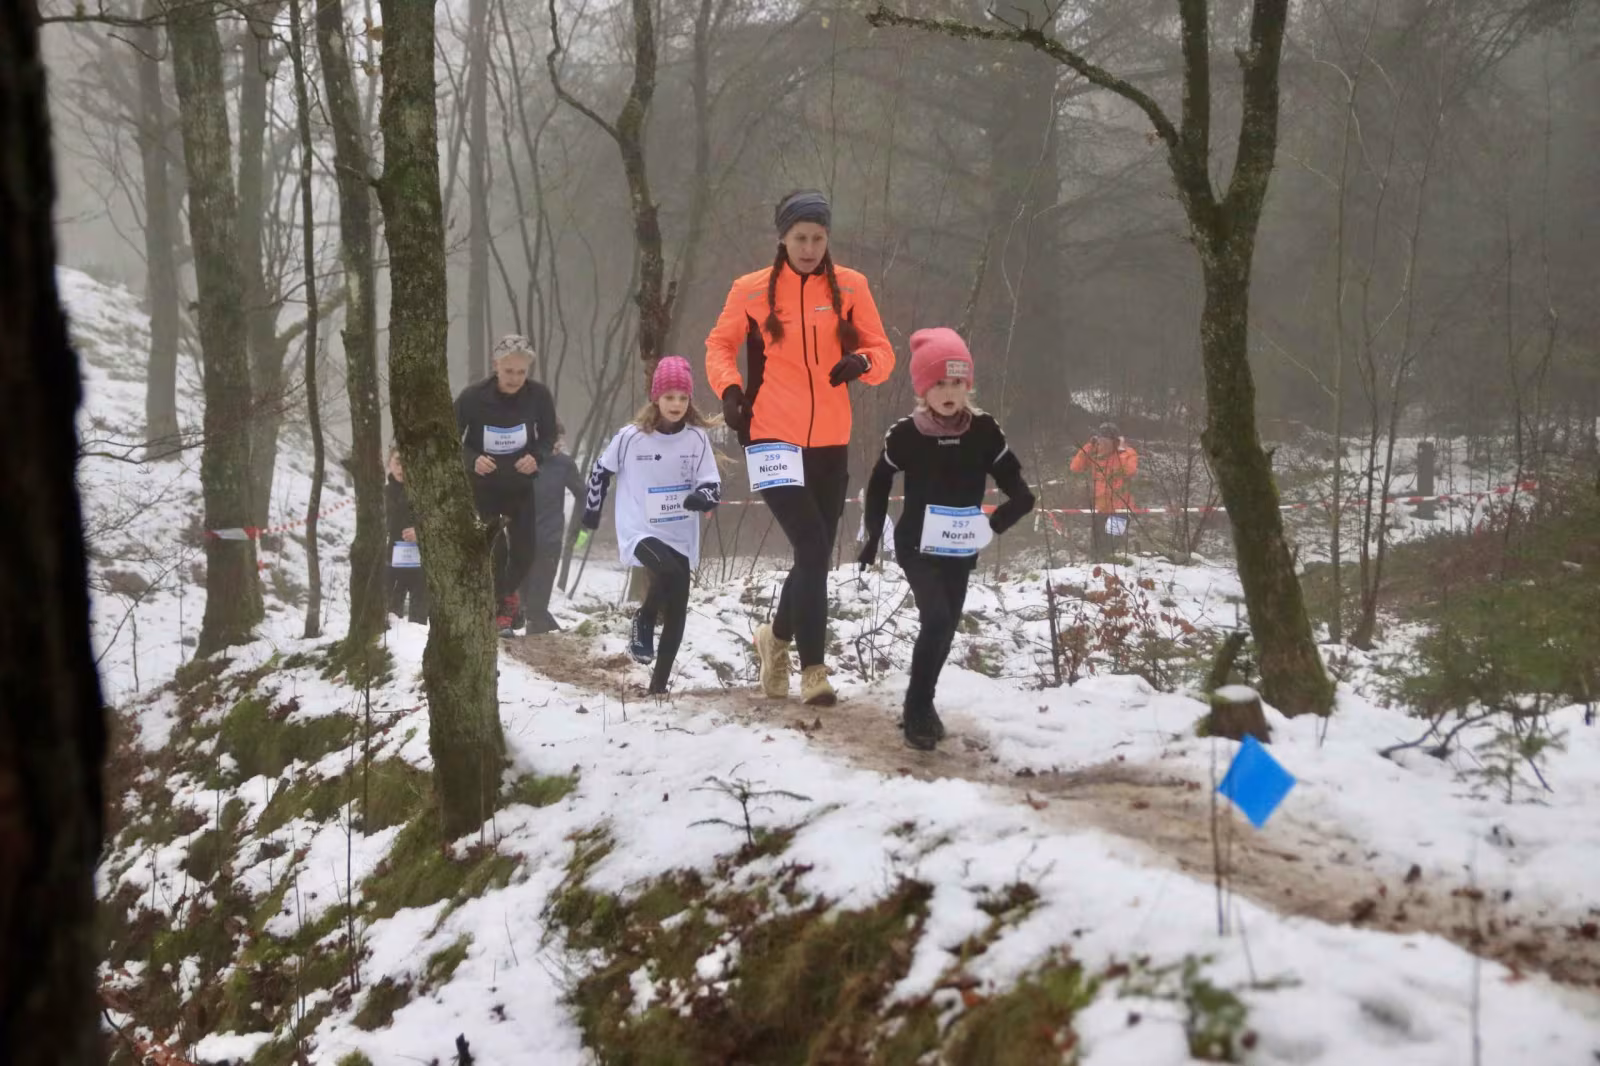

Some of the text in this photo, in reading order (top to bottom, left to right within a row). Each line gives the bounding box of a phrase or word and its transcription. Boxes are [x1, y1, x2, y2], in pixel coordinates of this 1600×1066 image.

[764, 453, 781, 461] 259
[759, 463, 788, 473] Nicole
[661, 503, 681, 511] Bjørk
[952, 520, 970, 528] 257
[941, 530, 976, 540] Norah
